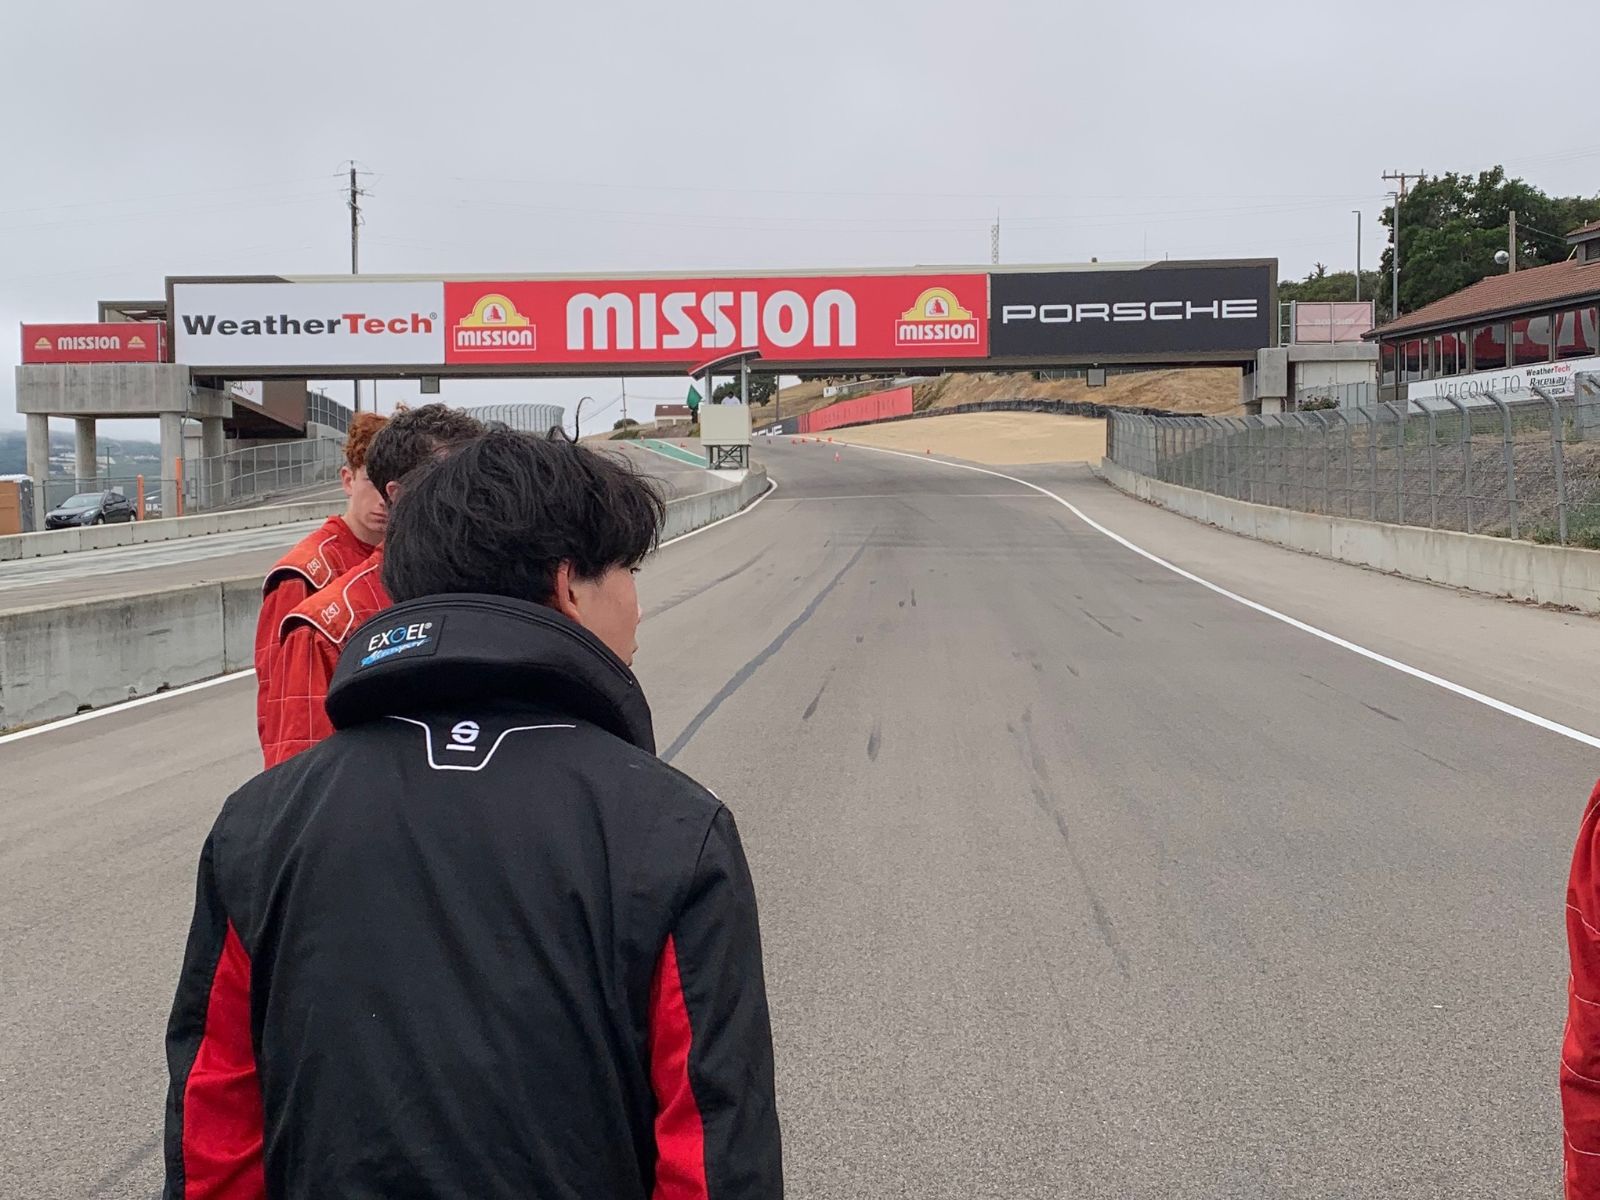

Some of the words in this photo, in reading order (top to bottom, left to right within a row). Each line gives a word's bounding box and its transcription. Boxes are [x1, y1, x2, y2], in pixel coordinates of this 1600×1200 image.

[566, 289, 857, 350] MISSION
[1002, 299, 1258, 324] PORSCHE
[457, 329, 532, 346] MISSION
[899, 323, 975, 340] MISSION
[57, 336, 120, 350] MISSION
[1434, 378, 1497, 401] WELCOME
[1502, 374, 1521, 395] TO
